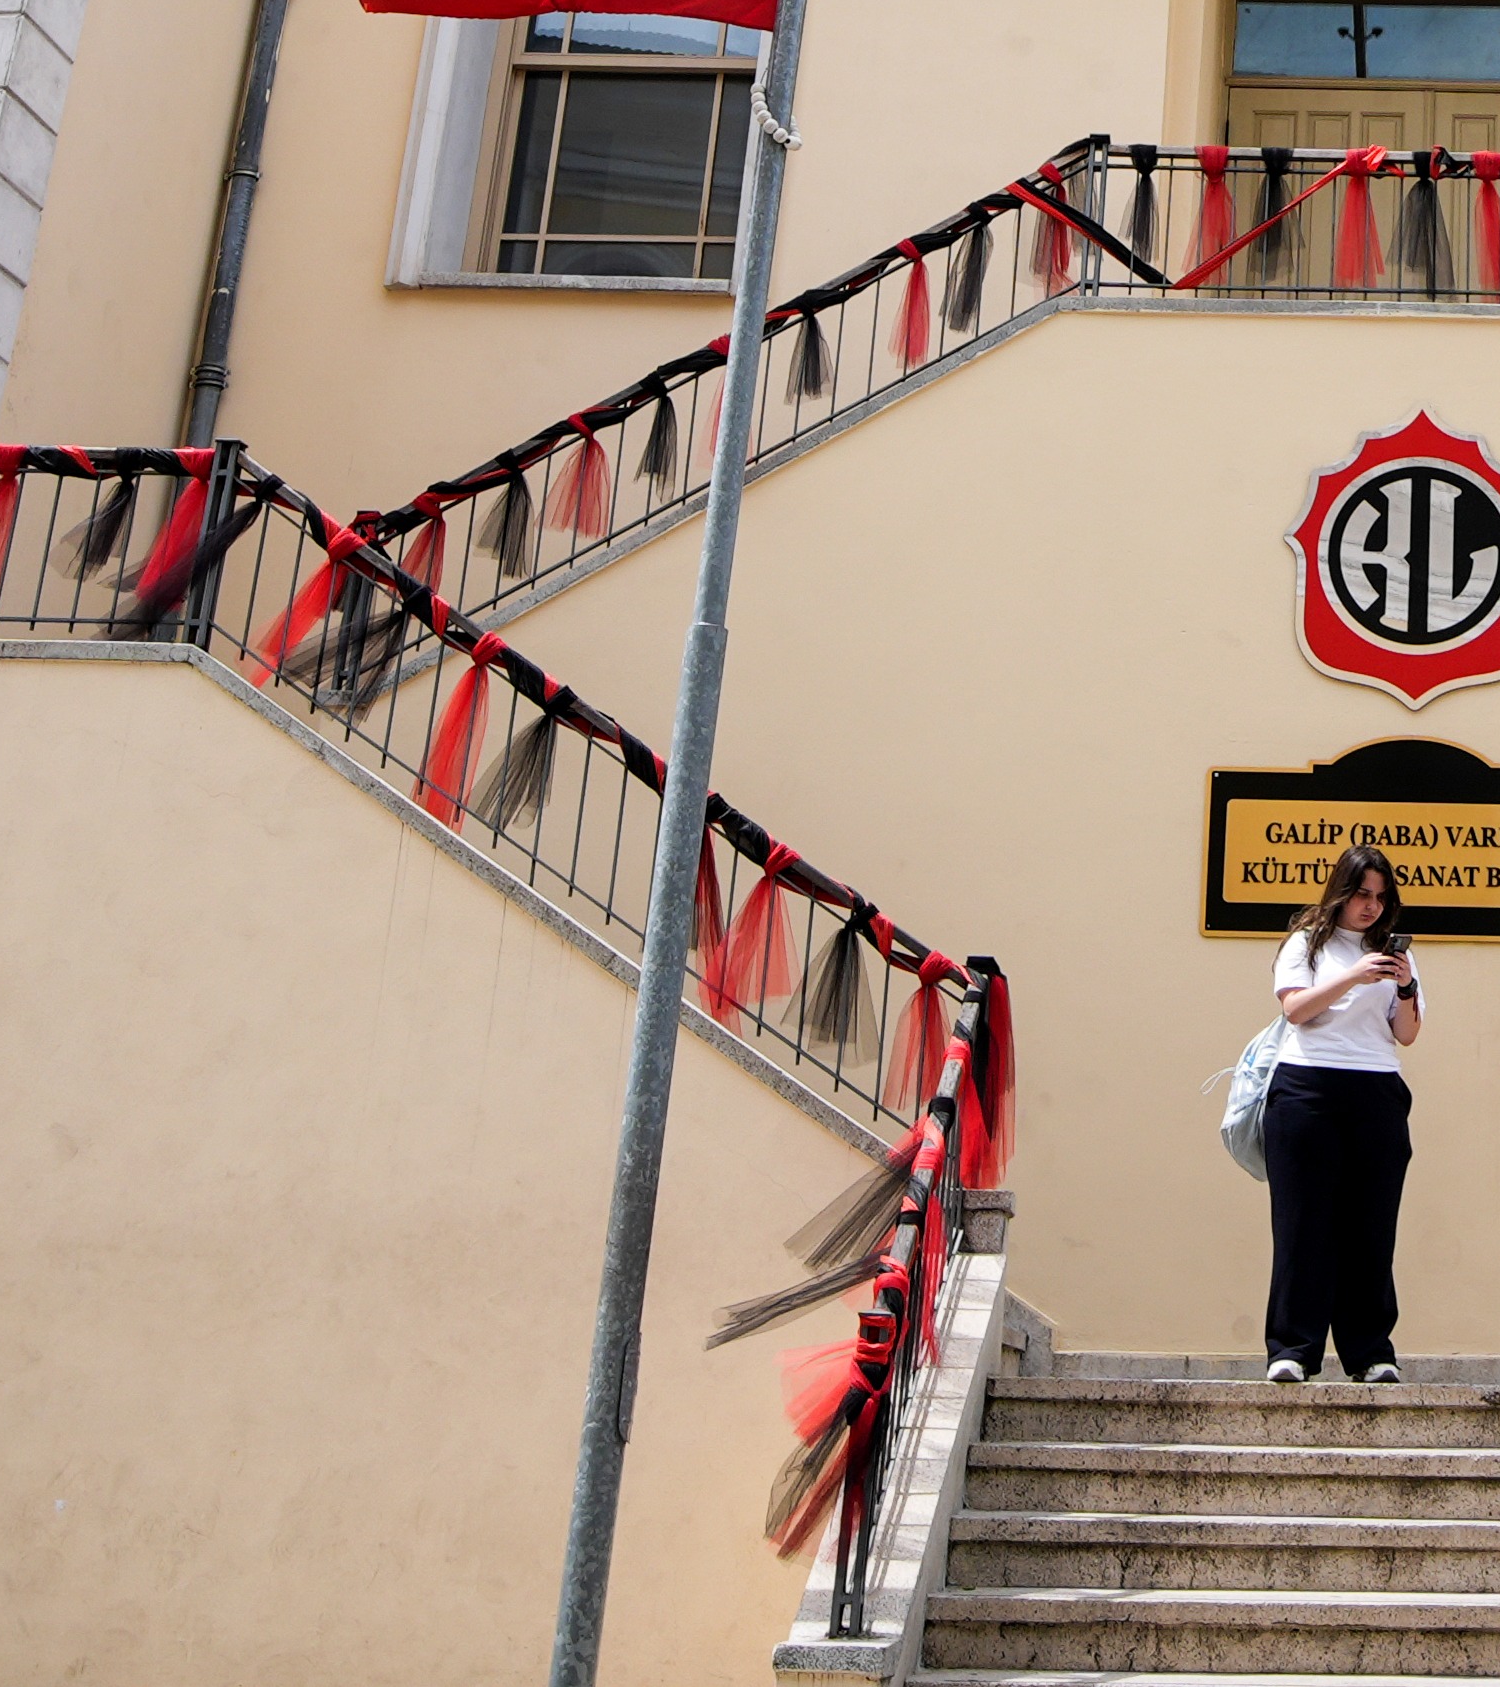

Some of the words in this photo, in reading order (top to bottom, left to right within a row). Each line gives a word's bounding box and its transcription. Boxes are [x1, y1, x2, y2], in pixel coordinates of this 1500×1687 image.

[1264, 817, 1344, 845] GALİP
[1349, 821, 1439, 850] (BABA)
[1241, 855, 1336, 885] KÜLTÜ
[1394, 863, 1480, 889] SANAT
